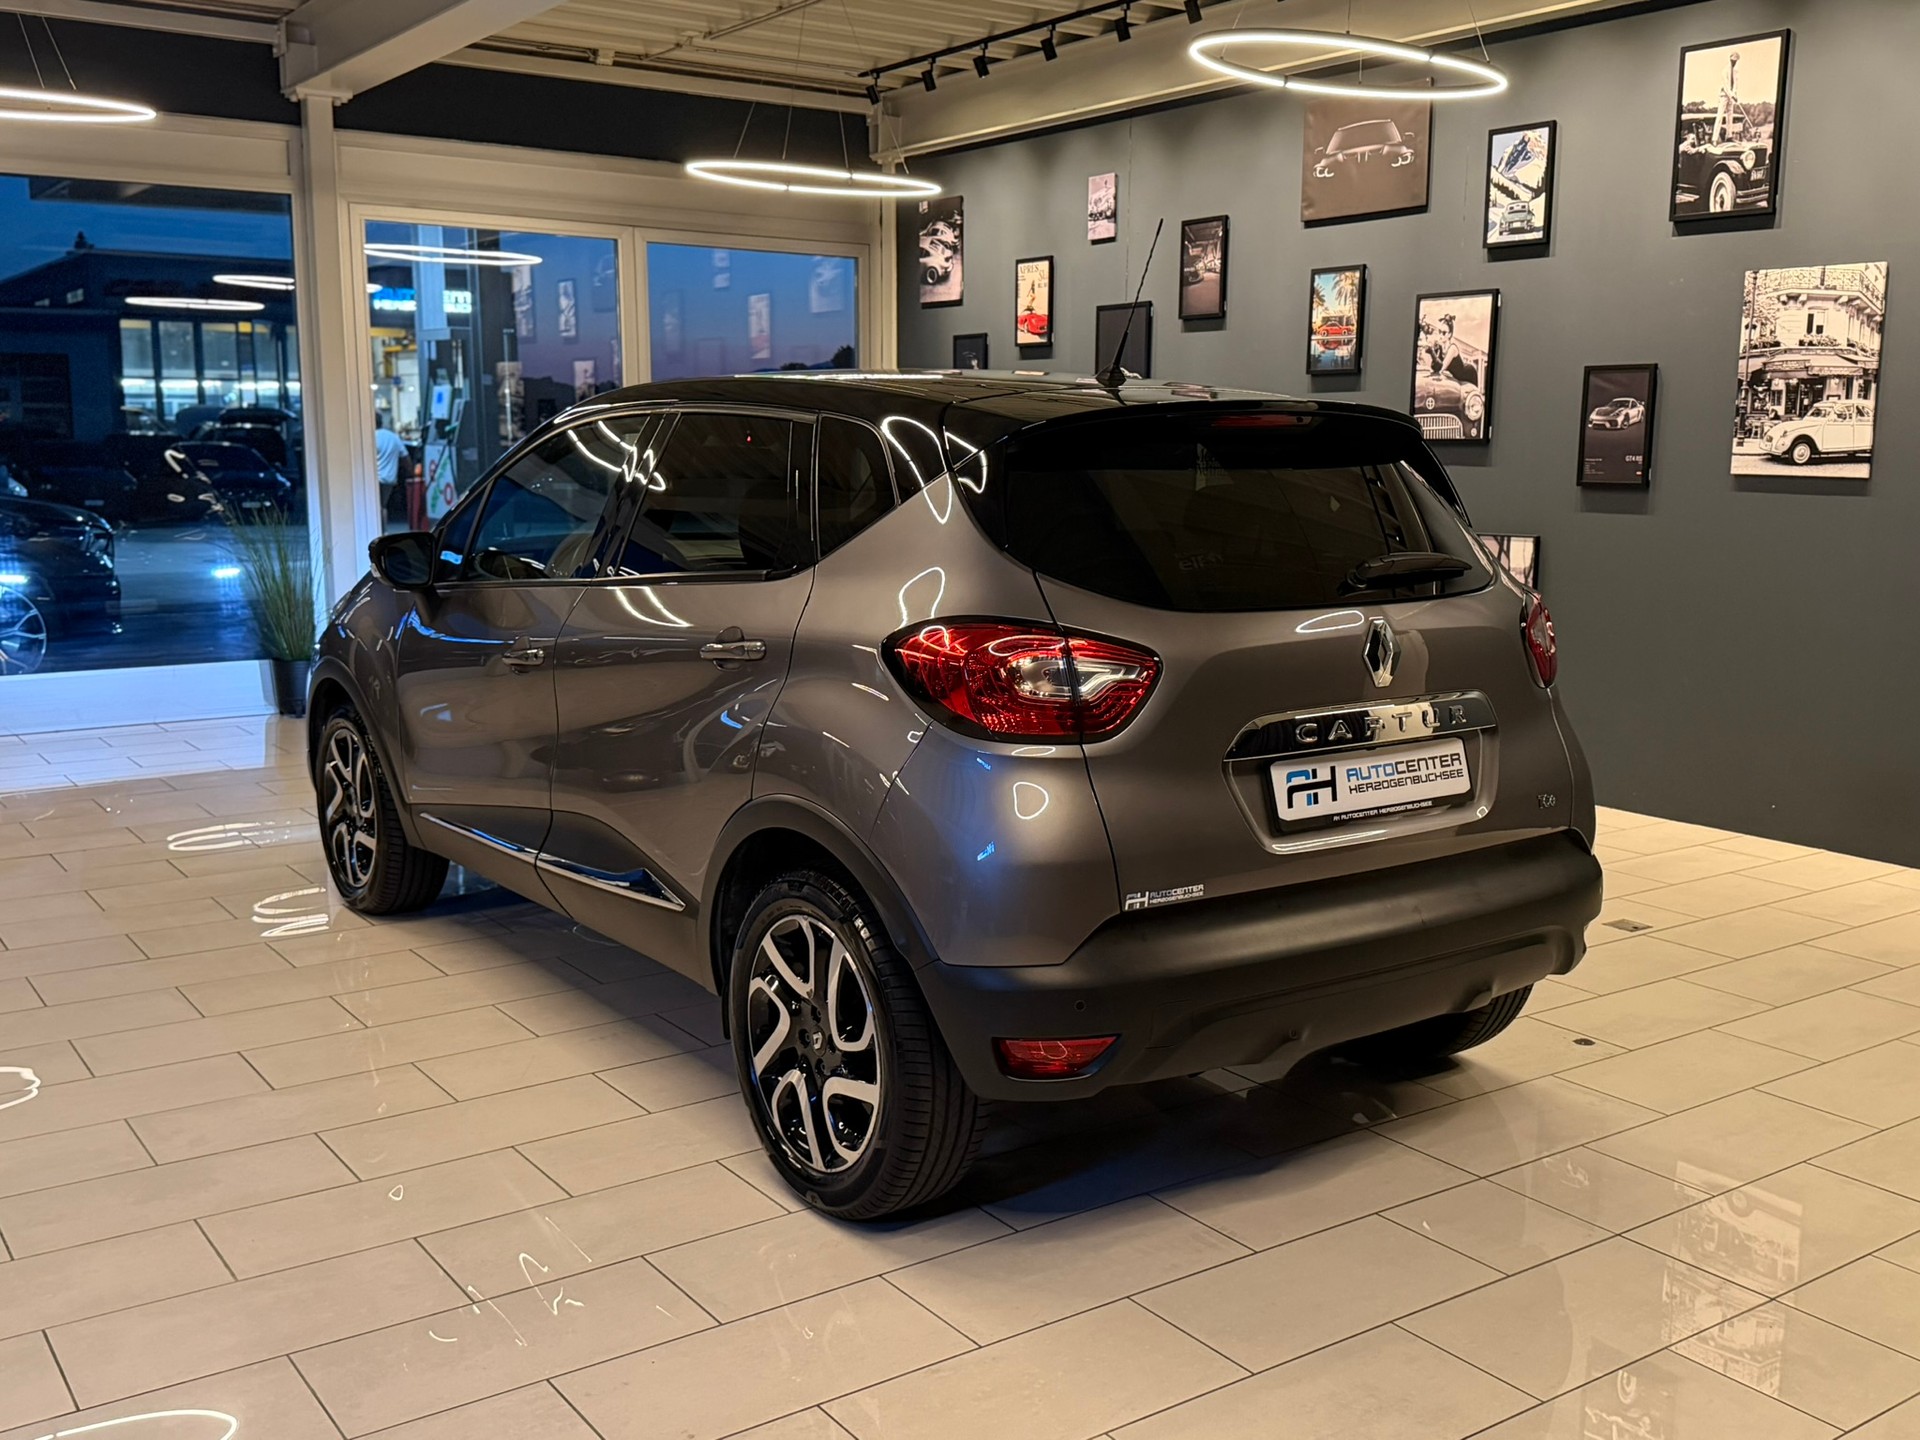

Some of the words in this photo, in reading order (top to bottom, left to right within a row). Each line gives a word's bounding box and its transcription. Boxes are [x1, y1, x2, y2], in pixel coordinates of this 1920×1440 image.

[1295, 704, 1467, 743] CAPTUR
[1346, 753, 1463, 782] AUTOCENTER
[1349, 769, 1464, 794] HERZOGENBUCHSEE
[1341, 809, 1378, 820] AUTOCENTER
[1379, 800, 1433, 814] HERZOGENBUCHSEE
[1150, 884, 1204, 898] AUTOCENTER
[1150, 891, 1204, 904] HERZOGENBUCHSEE
